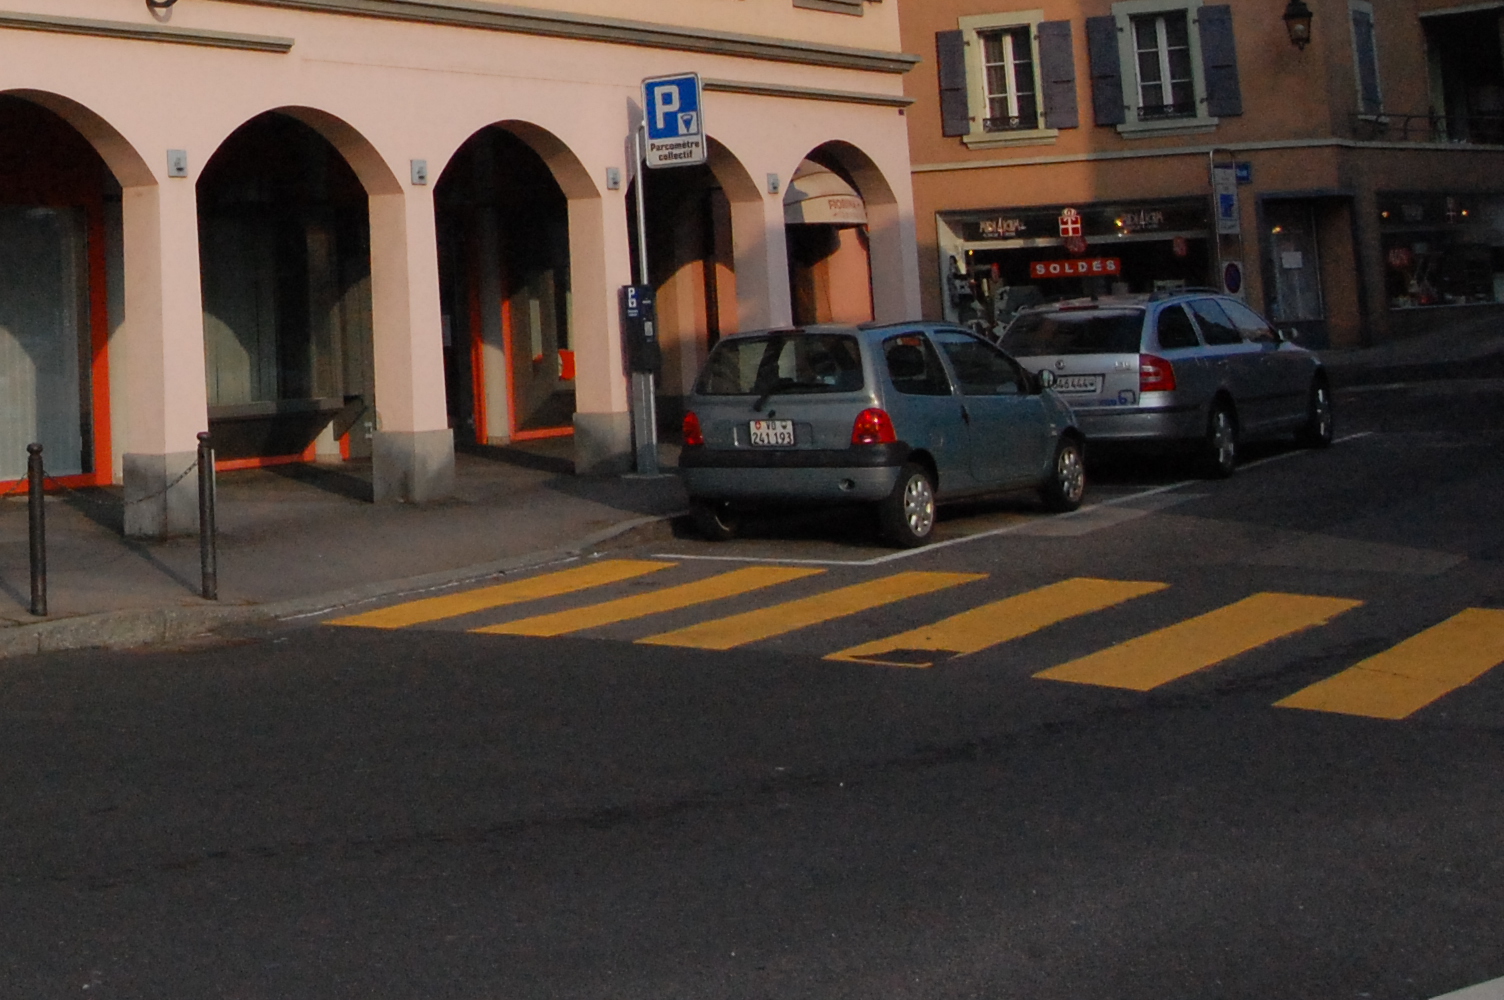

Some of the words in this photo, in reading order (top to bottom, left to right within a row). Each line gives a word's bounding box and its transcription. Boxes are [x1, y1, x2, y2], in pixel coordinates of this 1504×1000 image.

[654, 85, 680, 129] P
[650, 140, 700, 151] Parcomètre
[658, 150, 693, 161] collectif
[1035, 260, 1116, 275] SOLDES
[752, 432, 770, 445] 241
[774, 432, 792, 445] 193
